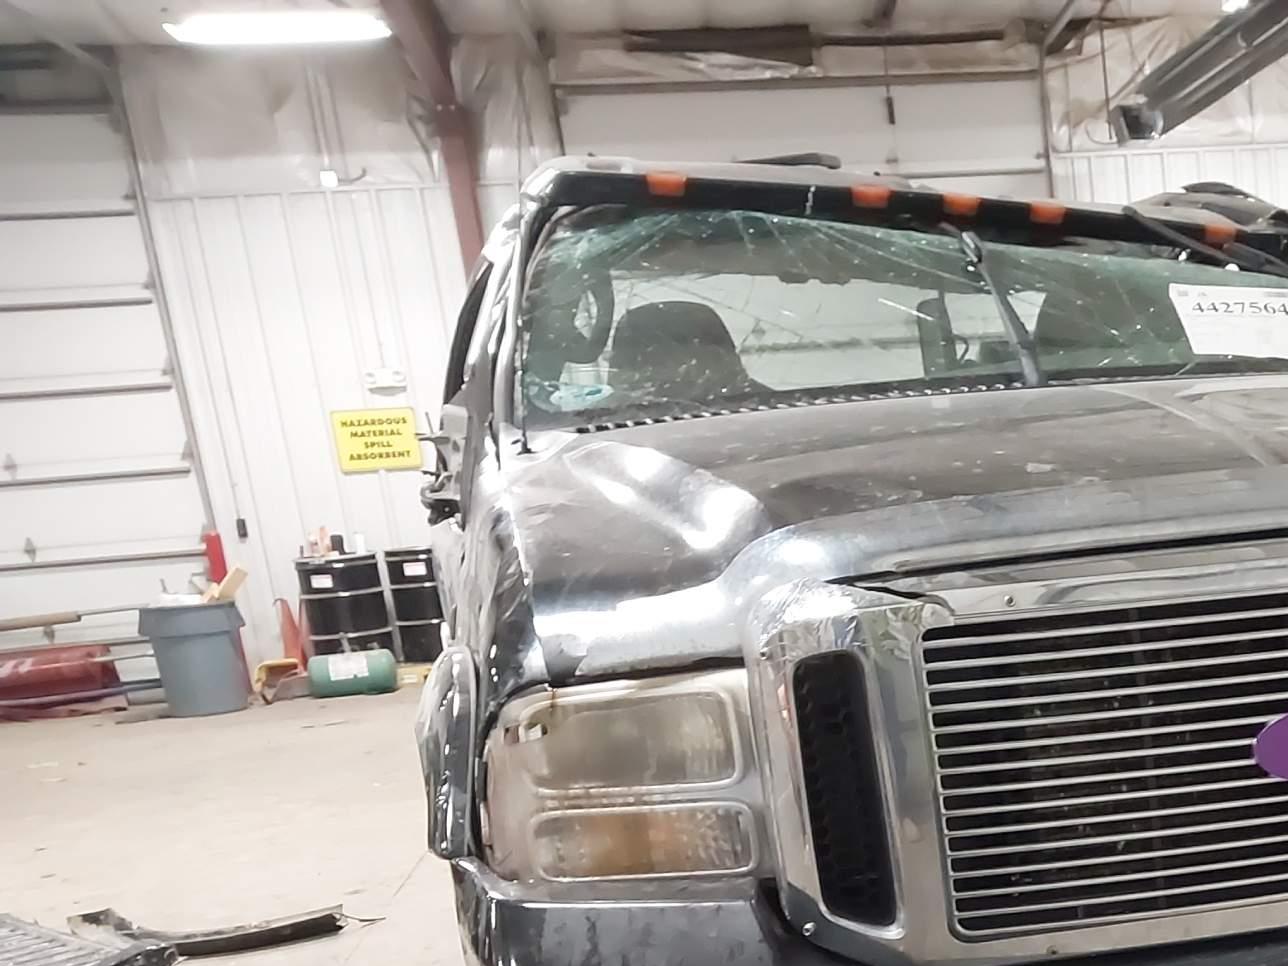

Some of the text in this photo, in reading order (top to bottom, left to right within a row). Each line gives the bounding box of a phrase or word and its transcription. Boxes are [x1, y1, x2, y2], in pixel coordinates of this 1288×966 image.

[340, 417, 408, 428] HAZARDOUS
[350, 428, 403, 438] MATERIAL
[364, 440, 393, 449] SPILL
[349, 450, 411, 461] ABSORBENT
